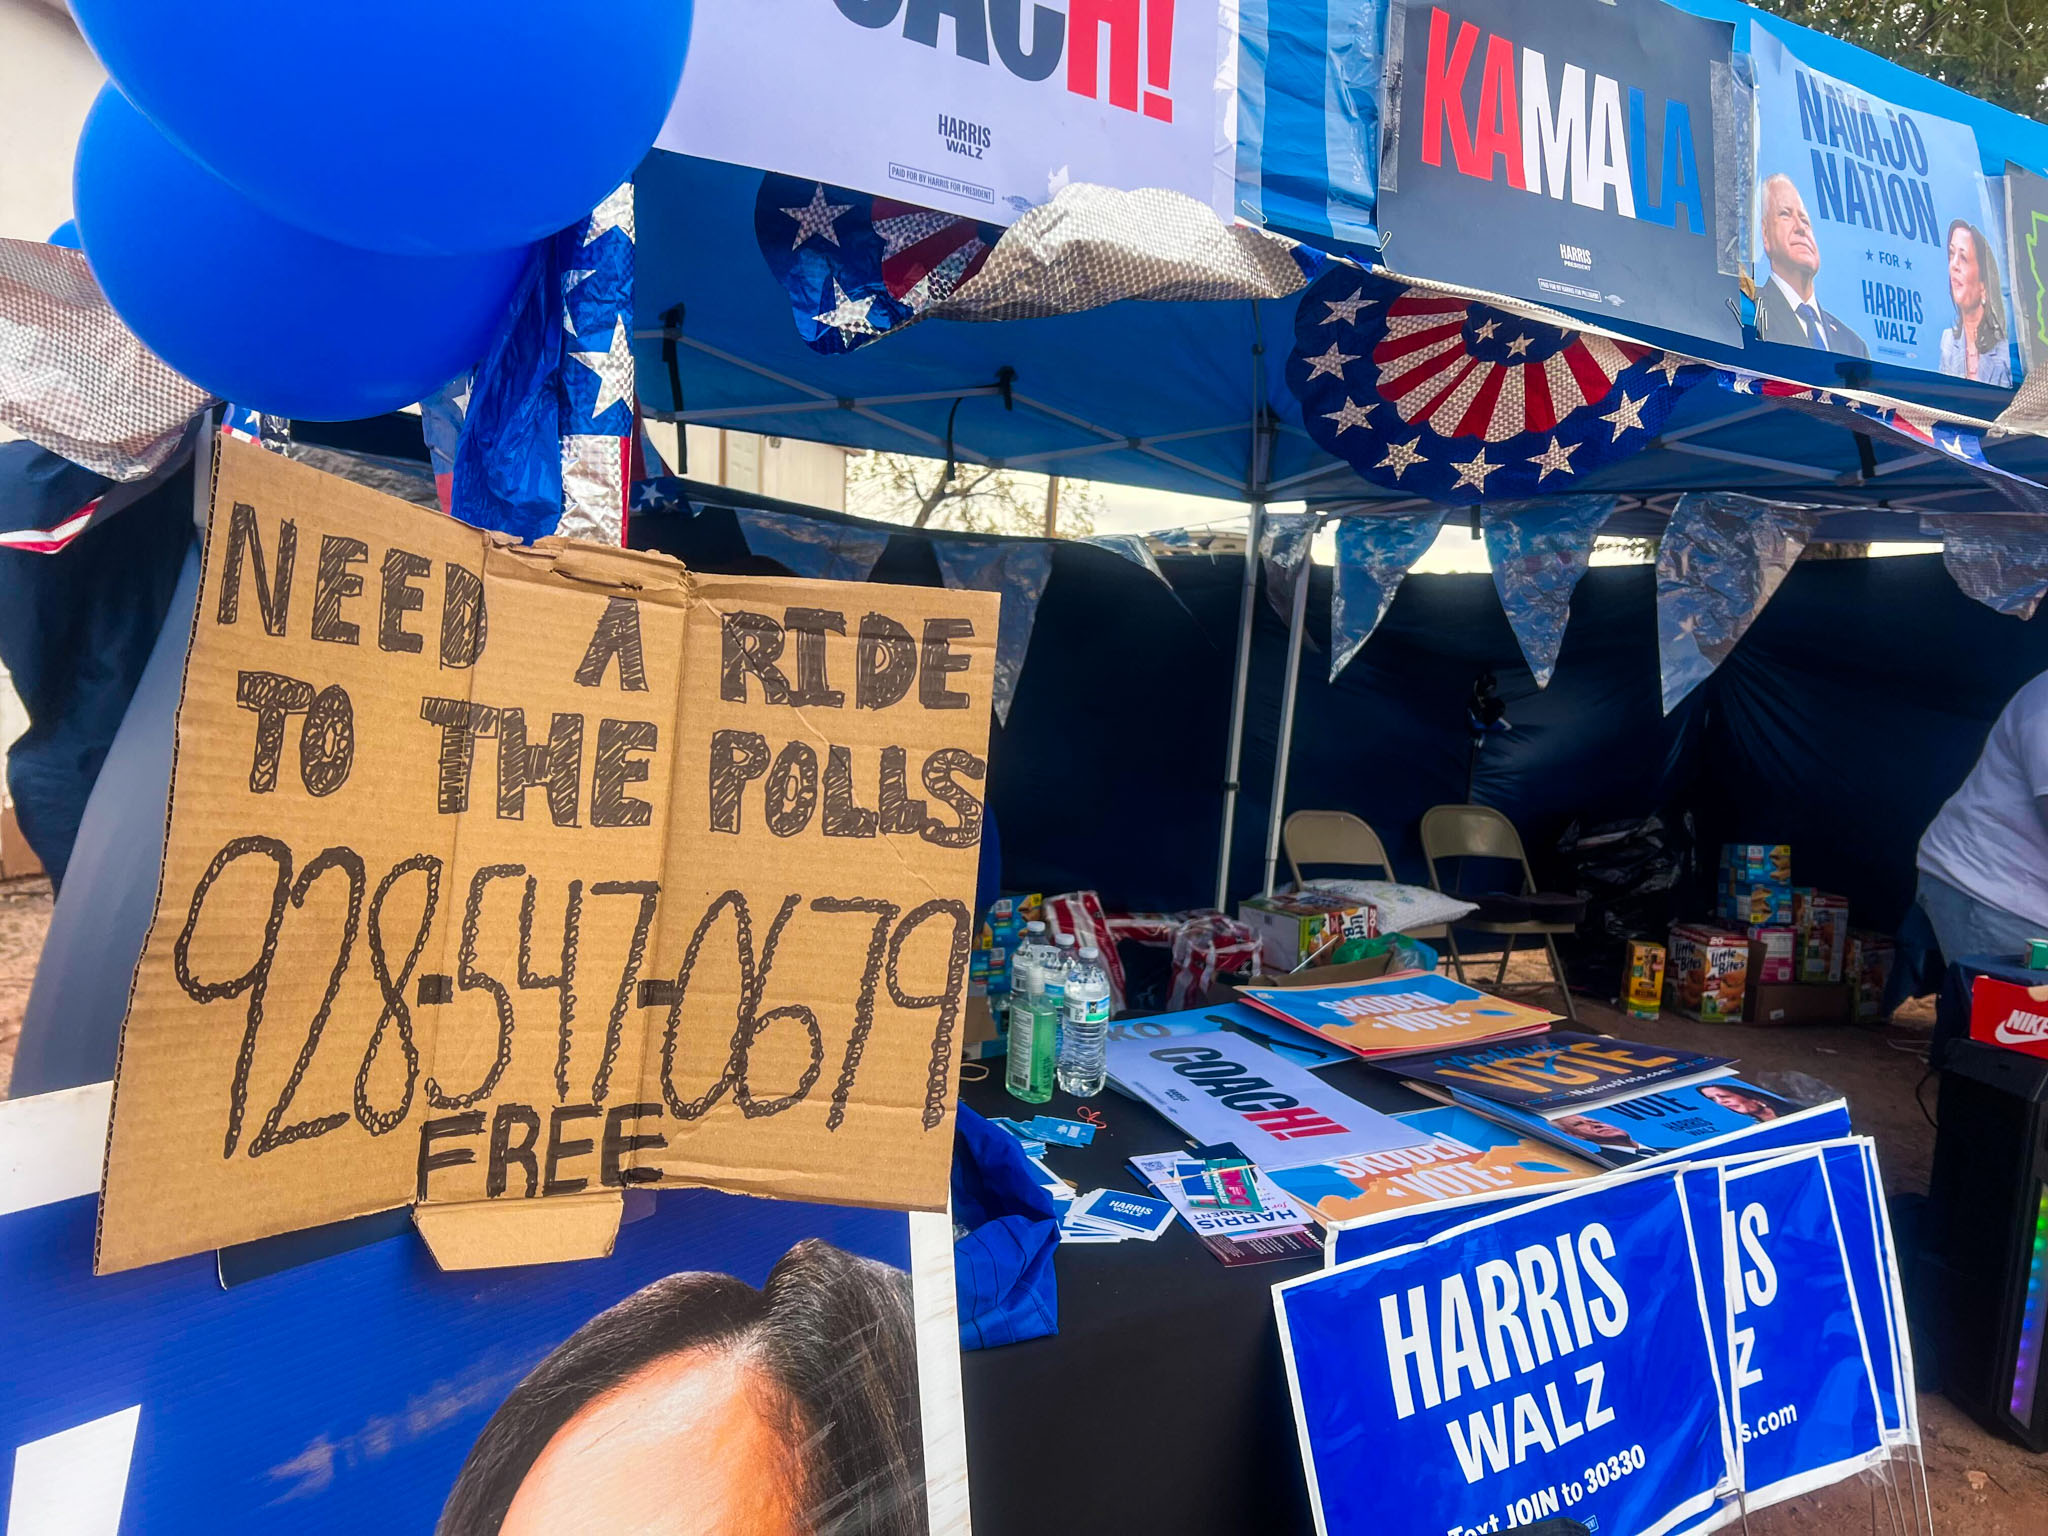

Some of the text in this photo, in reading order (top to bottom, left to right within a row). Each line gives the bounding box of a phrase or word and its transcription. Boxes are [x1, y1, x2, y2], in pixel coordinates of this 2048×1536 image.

[938, 113, 991, 149] HARRIS
[1422, 6, 1706, 236] KAMALA
[1795, 69, 1929, 177] NAVAJO
[946, 138, 983, 160] WALZ
[891, 166, 992, 201] PAID FOR BY HARRIS FOR PRESIDENT
[1810, 148, 1941, 248] NATION
[1559, 243, 1592, 265] HARRIS
[1878, 250, 1900, 268] FOR
[1861, 279, 1924, 325] HARRIS
[1874, 318, 1918, 346] WALZ
[217, 502, 973, 710] NEED A RIDE
[236, 669, 986, 849] TO THE POLLS
[1711, 948, 1737, 967] Little
[1718, 958, 1745, 976] Bites
[174, 836, 972, 1160] 928-547-0679
[1434, 1042, 1678, 1094] VOTE
[1150, 1046, 1351, 1141] COACH!
[418, 1102, 670, 1203] FREE
[1109, 1200, 1153, 1216] HARRIS
[1112, 1206, 1143, 1218] WALZ
[1196, 1209, 1298, 1230] HARRIS
[1379, 1222, 1629, 1420] HARRIS
[1446, 1361, 1616, 1484] WALZ
[1506, 1486, 1560, 1530] JOIN
[1562, 1482, 1583, 1507] to
[1584, 1444, 1646, 1494] 30330
